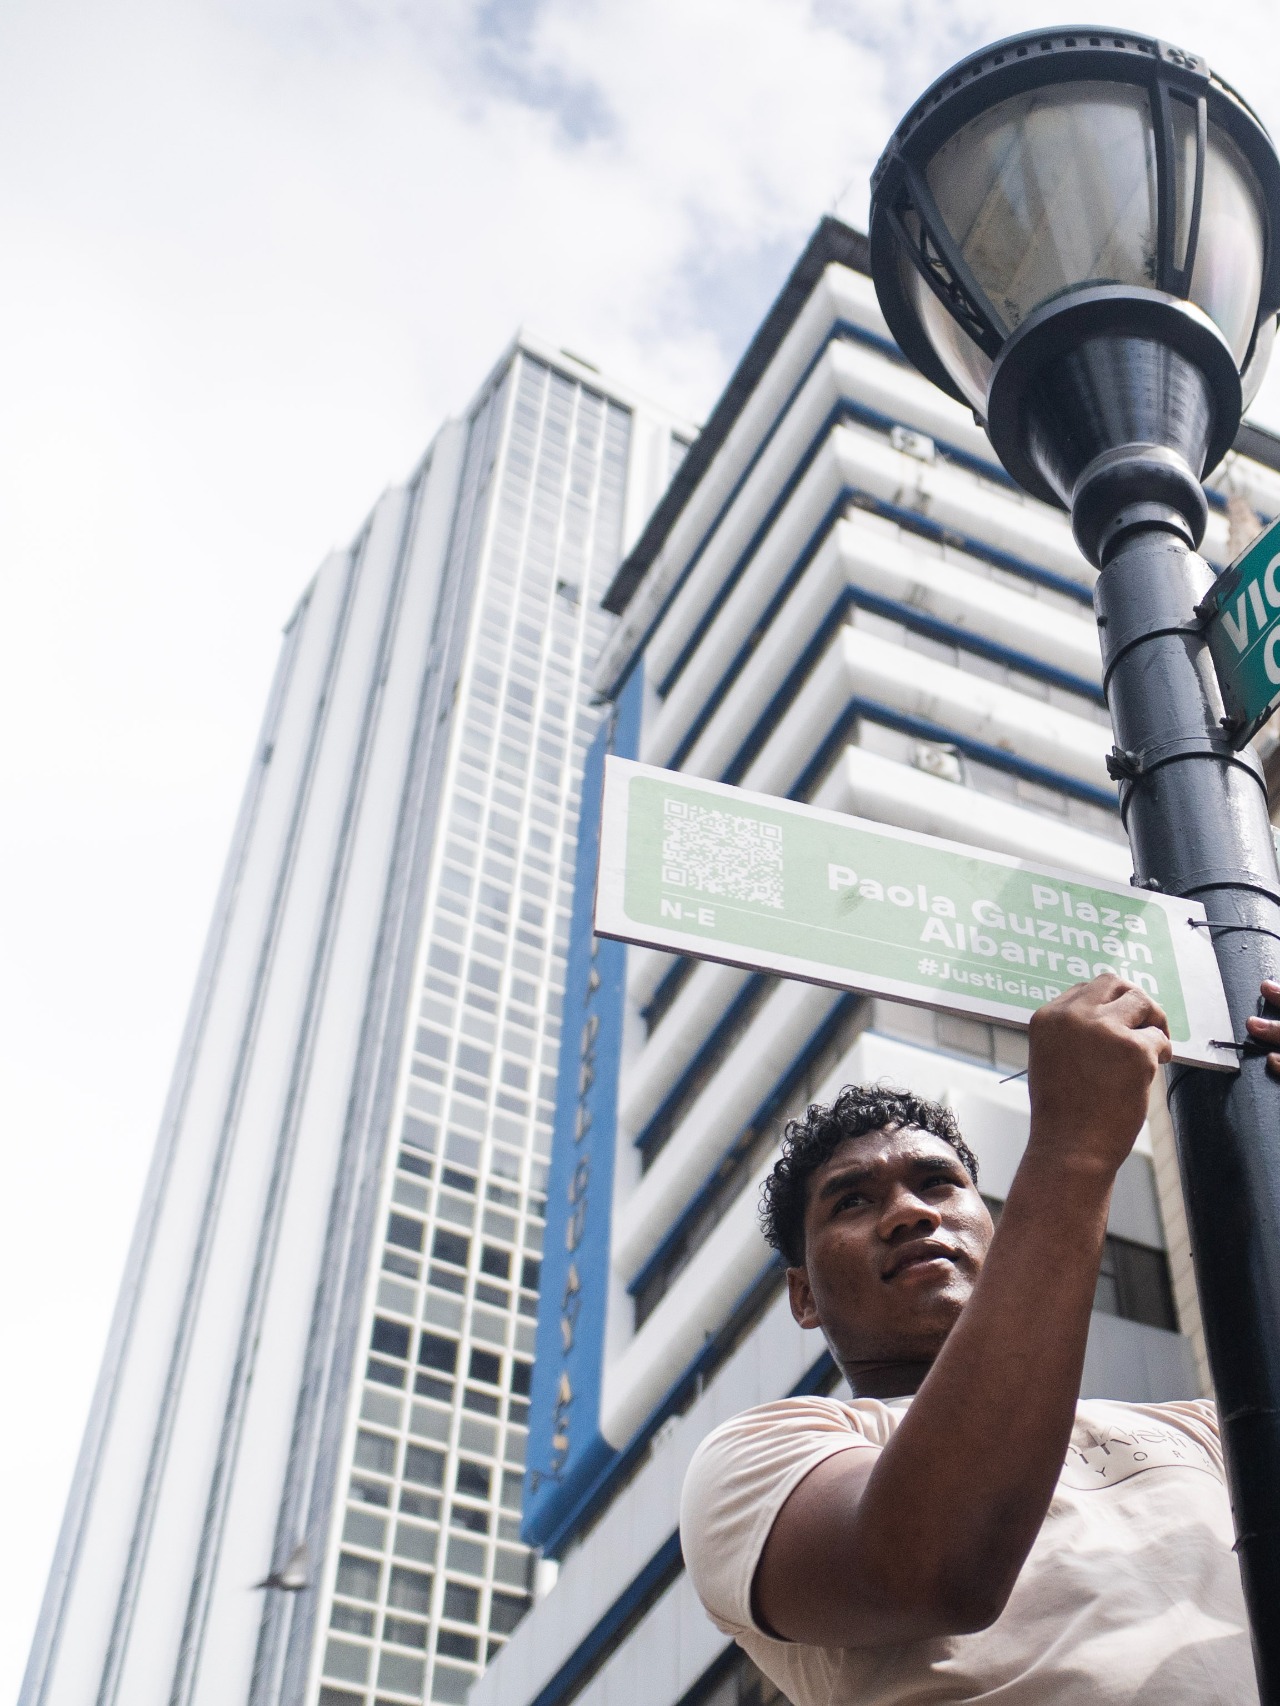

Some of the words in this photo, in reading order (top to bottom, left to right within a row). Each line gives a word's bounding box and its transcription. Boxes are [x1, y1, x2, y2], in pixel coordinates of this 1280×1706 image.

[660, 899, 716, 929] N-E
[828, 862, 957, 919] Paola
[972, 898, 1154, 965] Guzmán
[1033, 882, 1149, 936] Plaza
